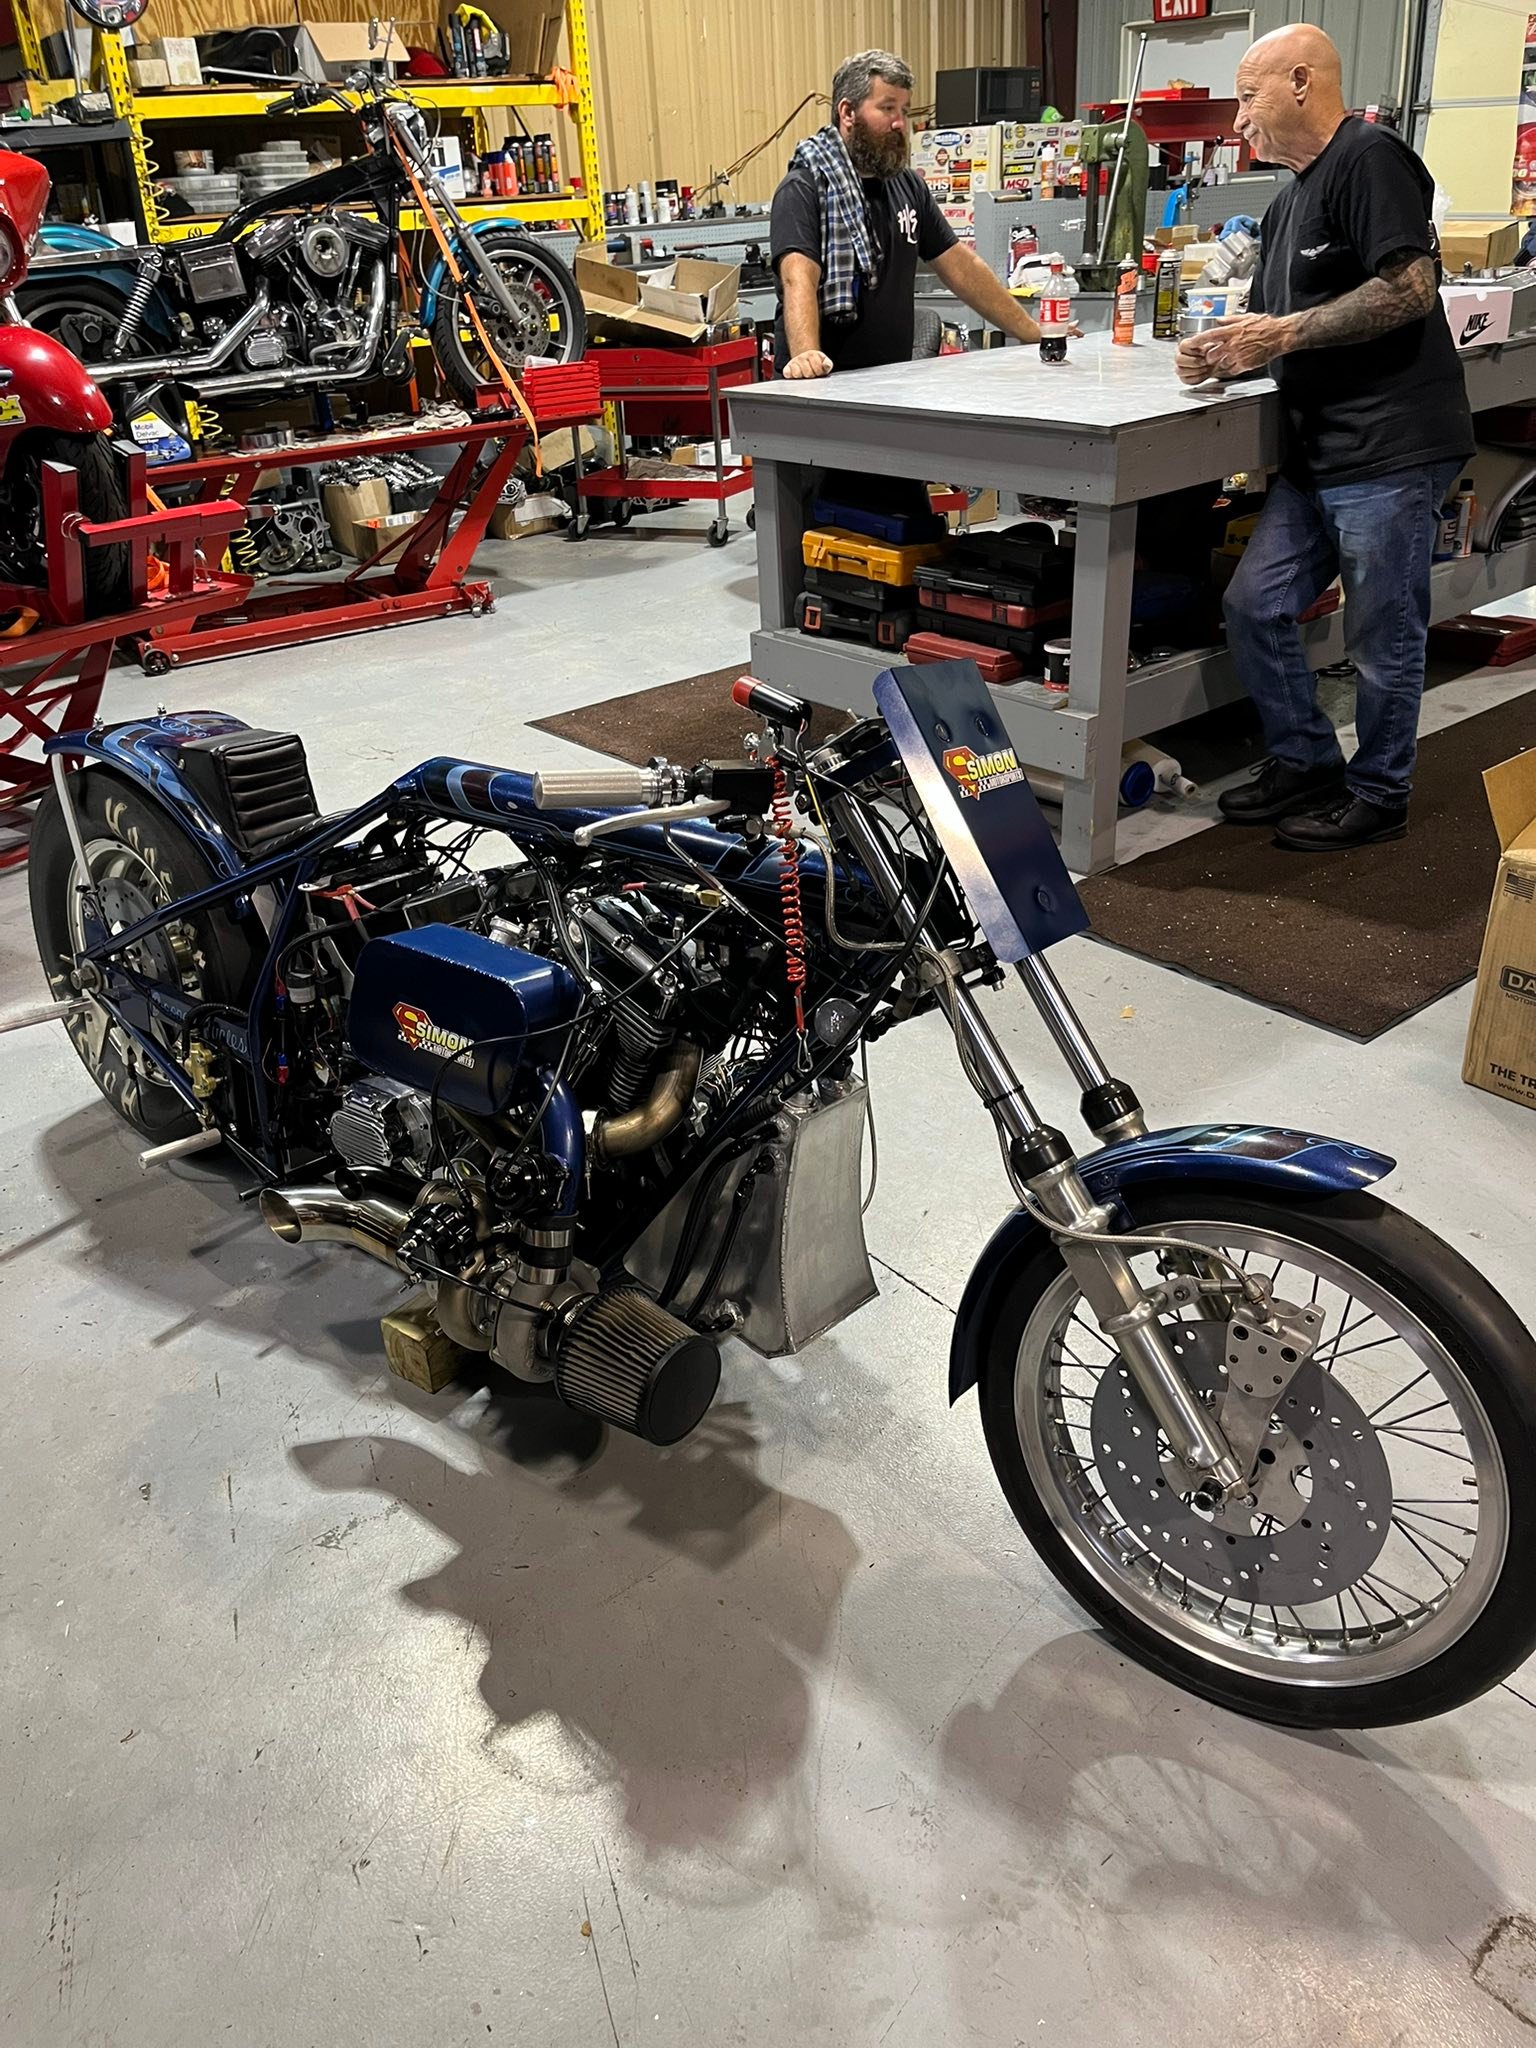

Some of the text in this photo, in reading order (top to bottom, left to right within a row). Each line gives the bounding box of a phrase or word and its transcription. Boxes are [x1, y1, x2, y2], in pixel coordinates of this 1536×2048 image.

[1006, 179, 1029, 190] MSD
[1465, 312, 1489, 331] NIKE
[966, 748, 1018, 781] SIMON
[1489, 1062, 1517, 1082] THE
[1497, 1081, 1536, 1100] www.D
